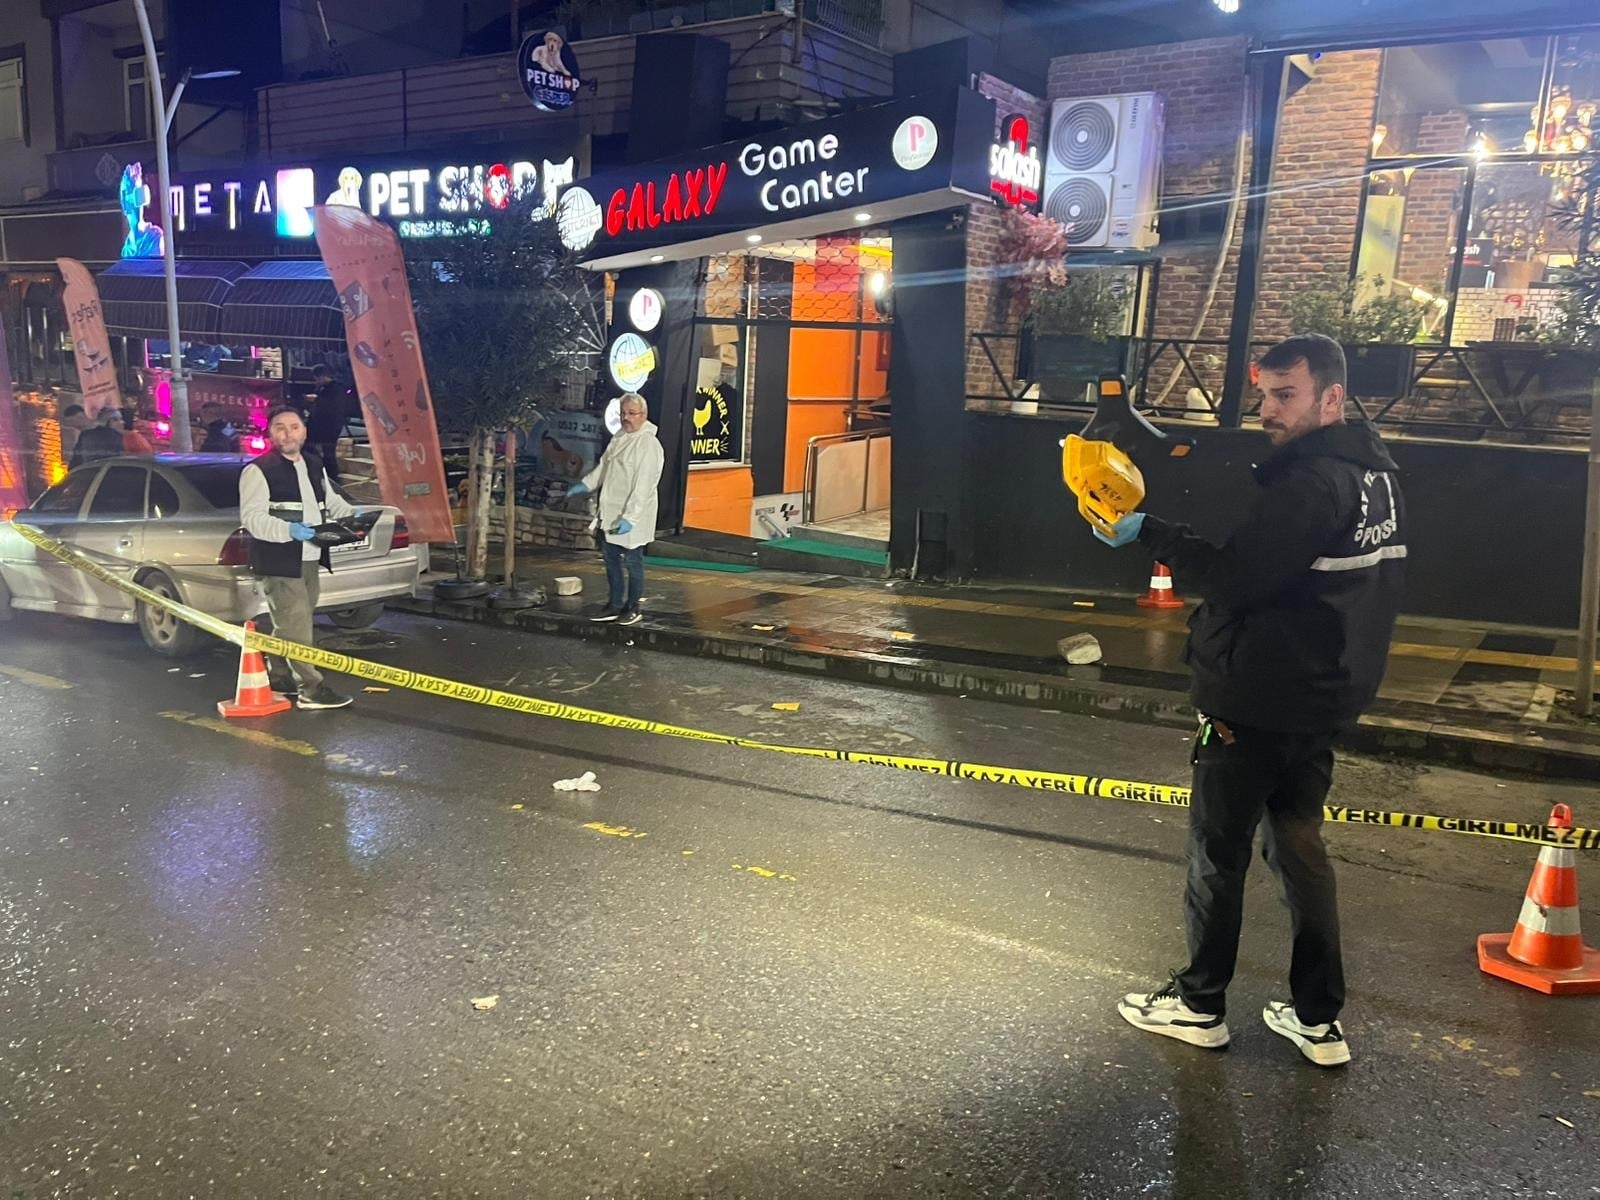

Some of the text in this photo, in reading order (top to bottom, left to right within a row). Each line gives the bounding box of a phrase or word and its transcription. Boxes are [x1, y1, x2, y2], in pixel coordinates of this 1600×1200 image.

[527, 68, 580, 92] PET SHOP
[738, 133, 839, 177] Game
[371, 161, 537, 217] PET SHOP
[606, 160, 729, 238] GALAXY
[760, 166, 869, 212] Canter
[1025, 777, 1076, 793] YERİ
[1110, 783, 1190, 806] GİRİLM
